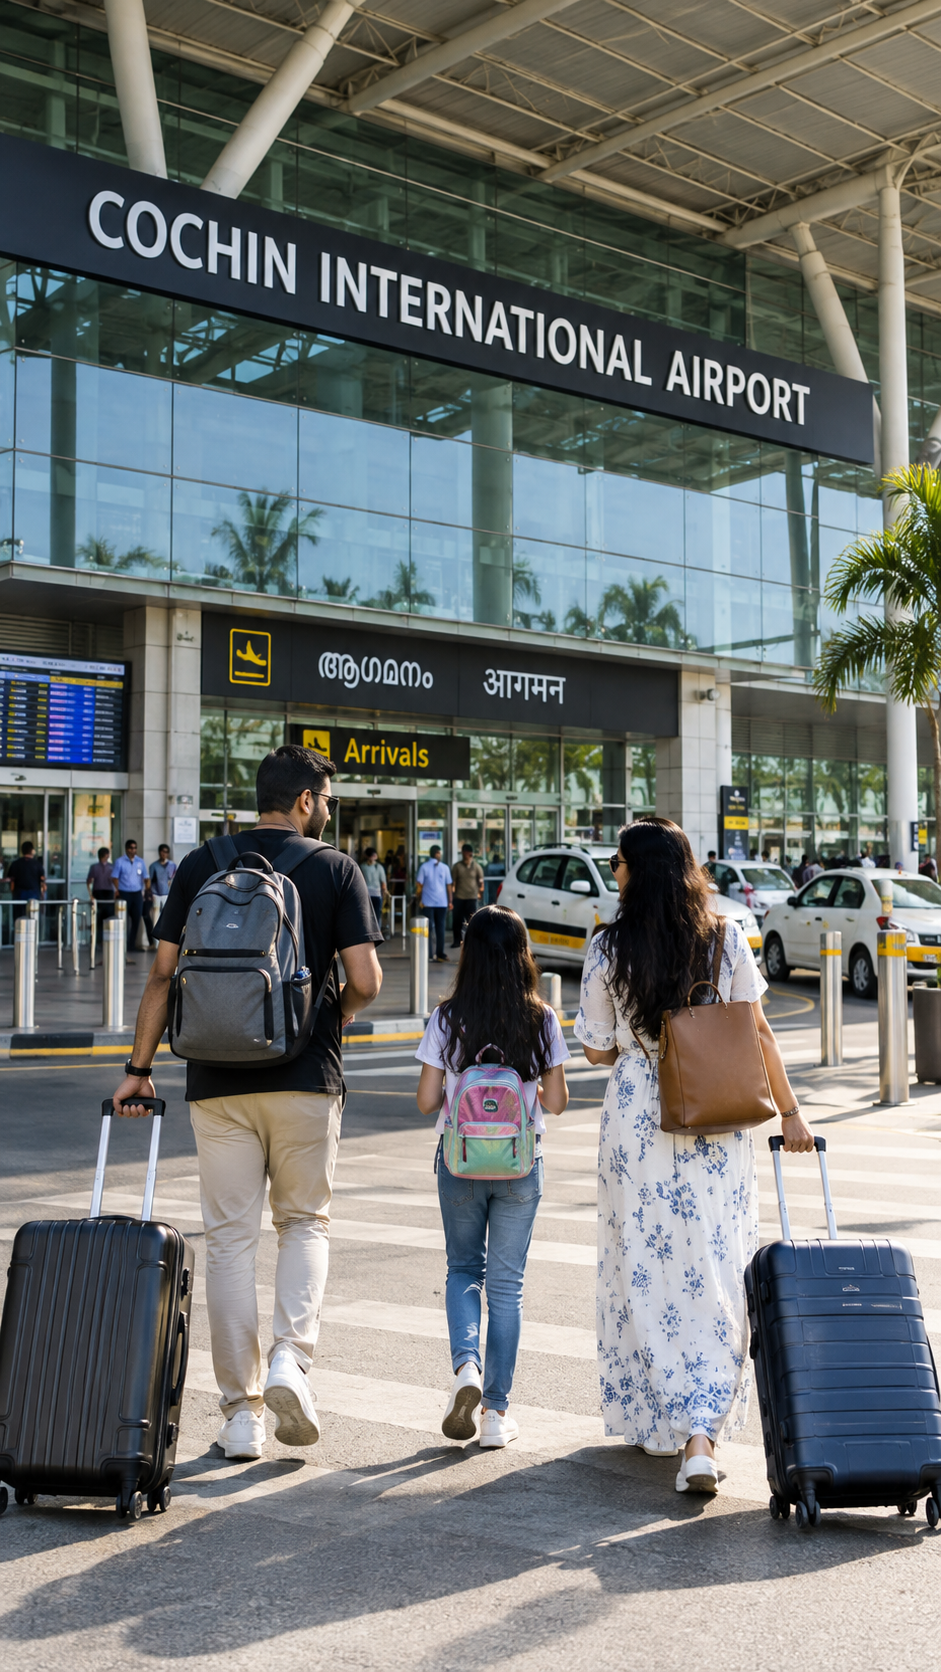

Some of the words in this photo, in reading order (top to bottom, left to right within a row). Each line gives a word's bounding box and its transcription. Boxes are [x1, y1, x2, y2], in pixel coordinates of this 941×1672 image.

[88, 190, 297, 295] COCHIN
[320, 251, 653, 386] INTERNATIONAL
[666, 350, 811, 426] AIRPORT
[318, 651, 434, 689] ആഗമനം
[483, 668, 567, 705] आगमन
[344, 737, 429, 768] Arrivals
